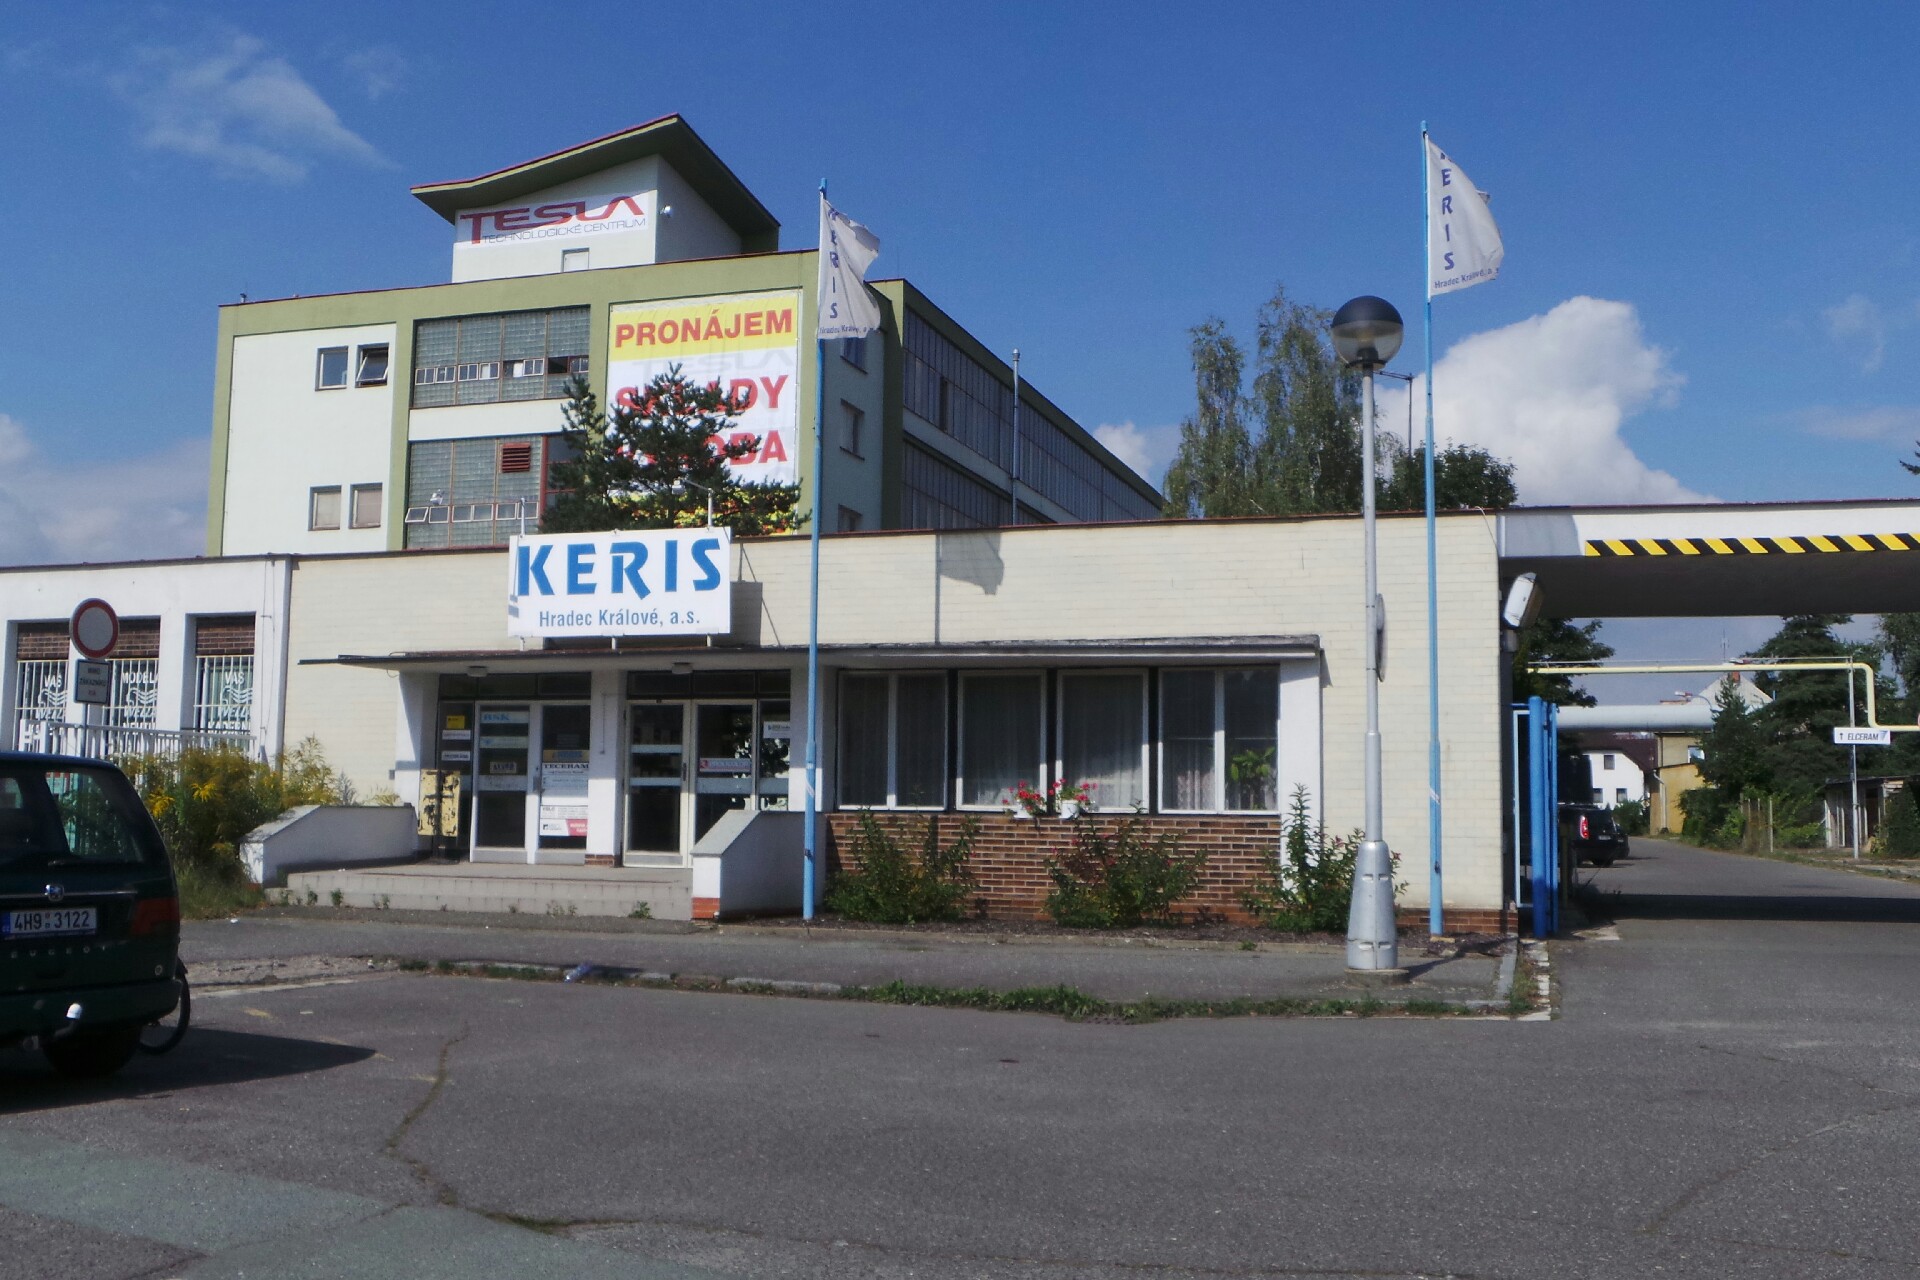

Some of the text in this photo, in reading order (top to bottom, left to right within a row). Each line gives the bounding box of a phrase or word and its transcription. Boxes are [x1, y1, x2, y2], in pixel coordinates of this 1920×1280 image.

[460, 195, 645, 245] TESLA
[1440, 152, 1455, 271] ERIS
[482, 218, 646, 244] TECHNOLOGICKÉ CENTRUM
[1434, 276, 1460, 289] Hradec
[615, 308, 793, 348] PRONÁJEM
[615, 375, 789, 418] SDY
[517, 537, 721, 600] KERIS
[539, 608, 700, 627] Hradec Králové, a.s.
[1847, 732, 1879, 741] ELCERAM
[14, 910, 90, 931] 4H9 3122
